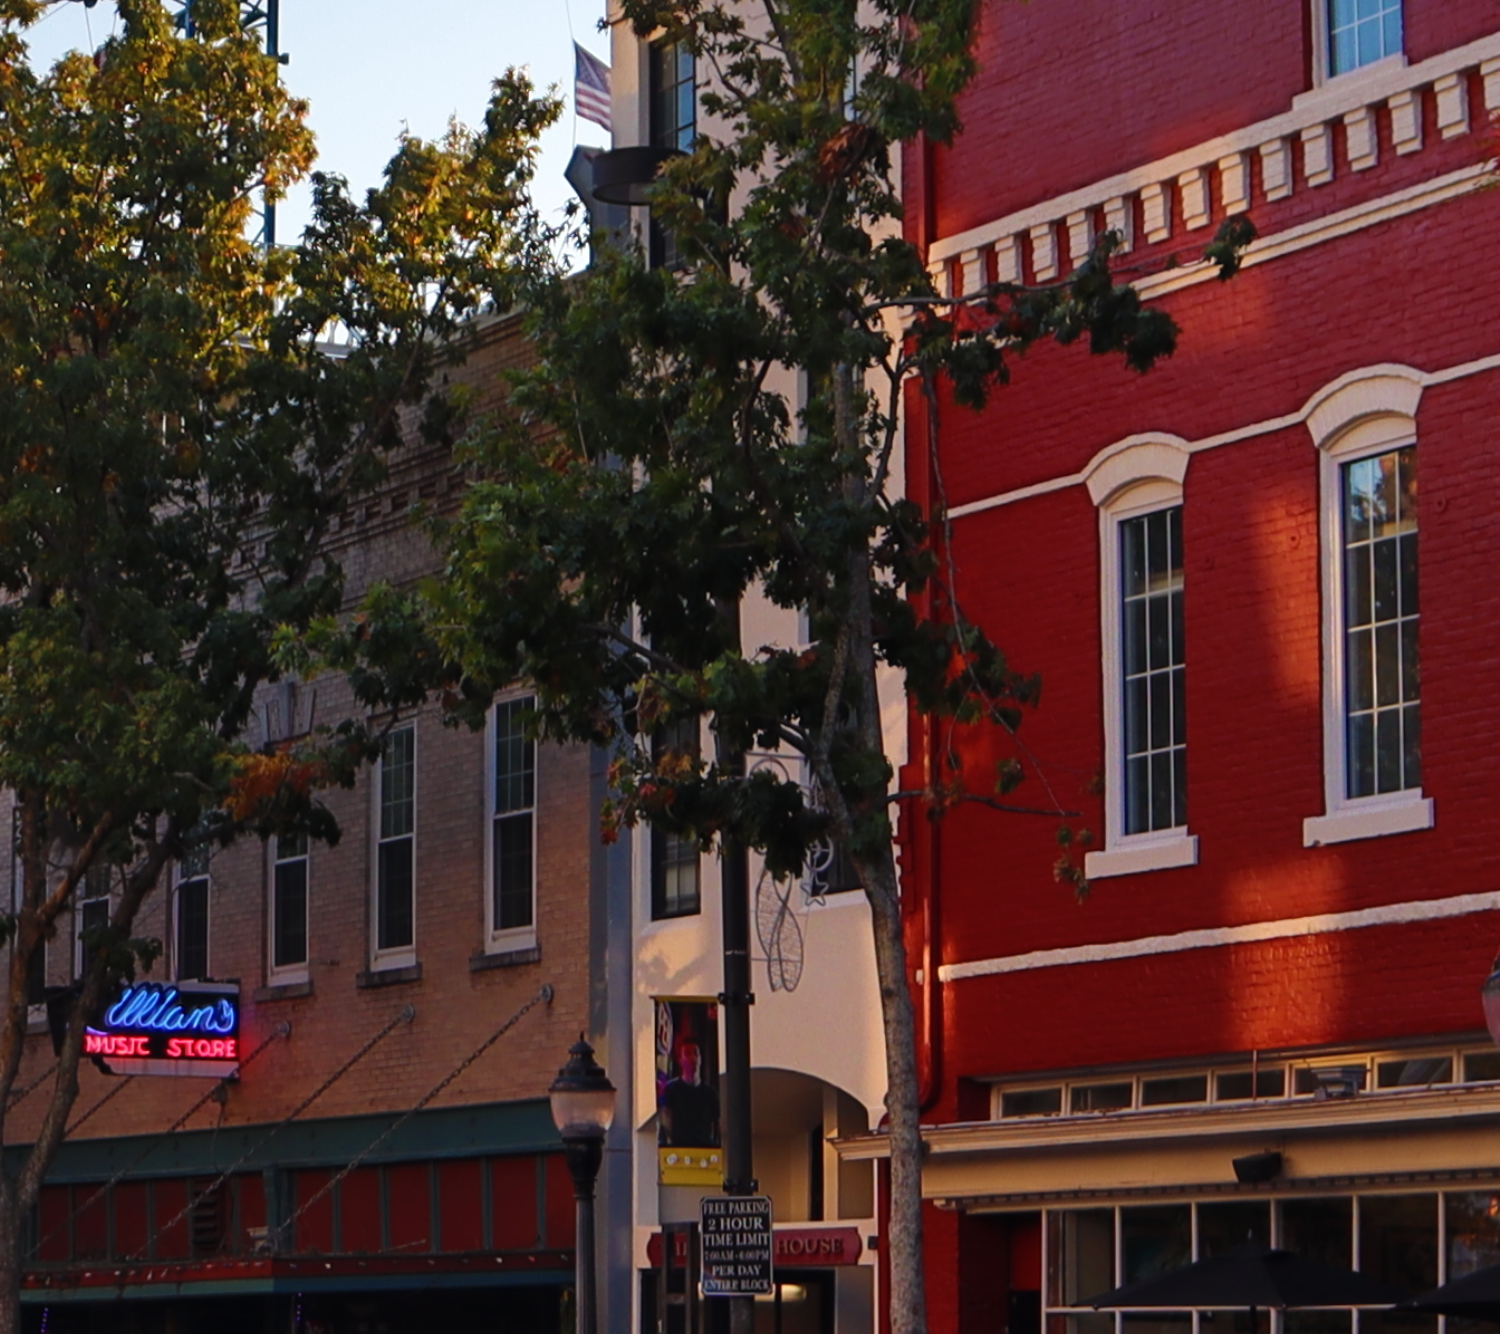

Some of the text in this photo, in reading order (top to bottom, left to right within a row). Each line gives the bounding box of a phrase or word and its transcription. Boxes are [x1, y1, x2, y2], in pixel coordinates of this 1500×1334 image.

[85, 1035, 237, 1058] MUSIC STORE
[703, 1201, 769, 1215] FREE PARKING
[708, 1217, 764, 1231] 2 HOUR
[703, 1233, 770, 1246] TIME LIMIT
[776, 1238, 843, 1255] HOUSE
[712, 1265, 761, 1276] PER DAY
[704, 1279, 769, 1290] ENTIRE BLOCK
